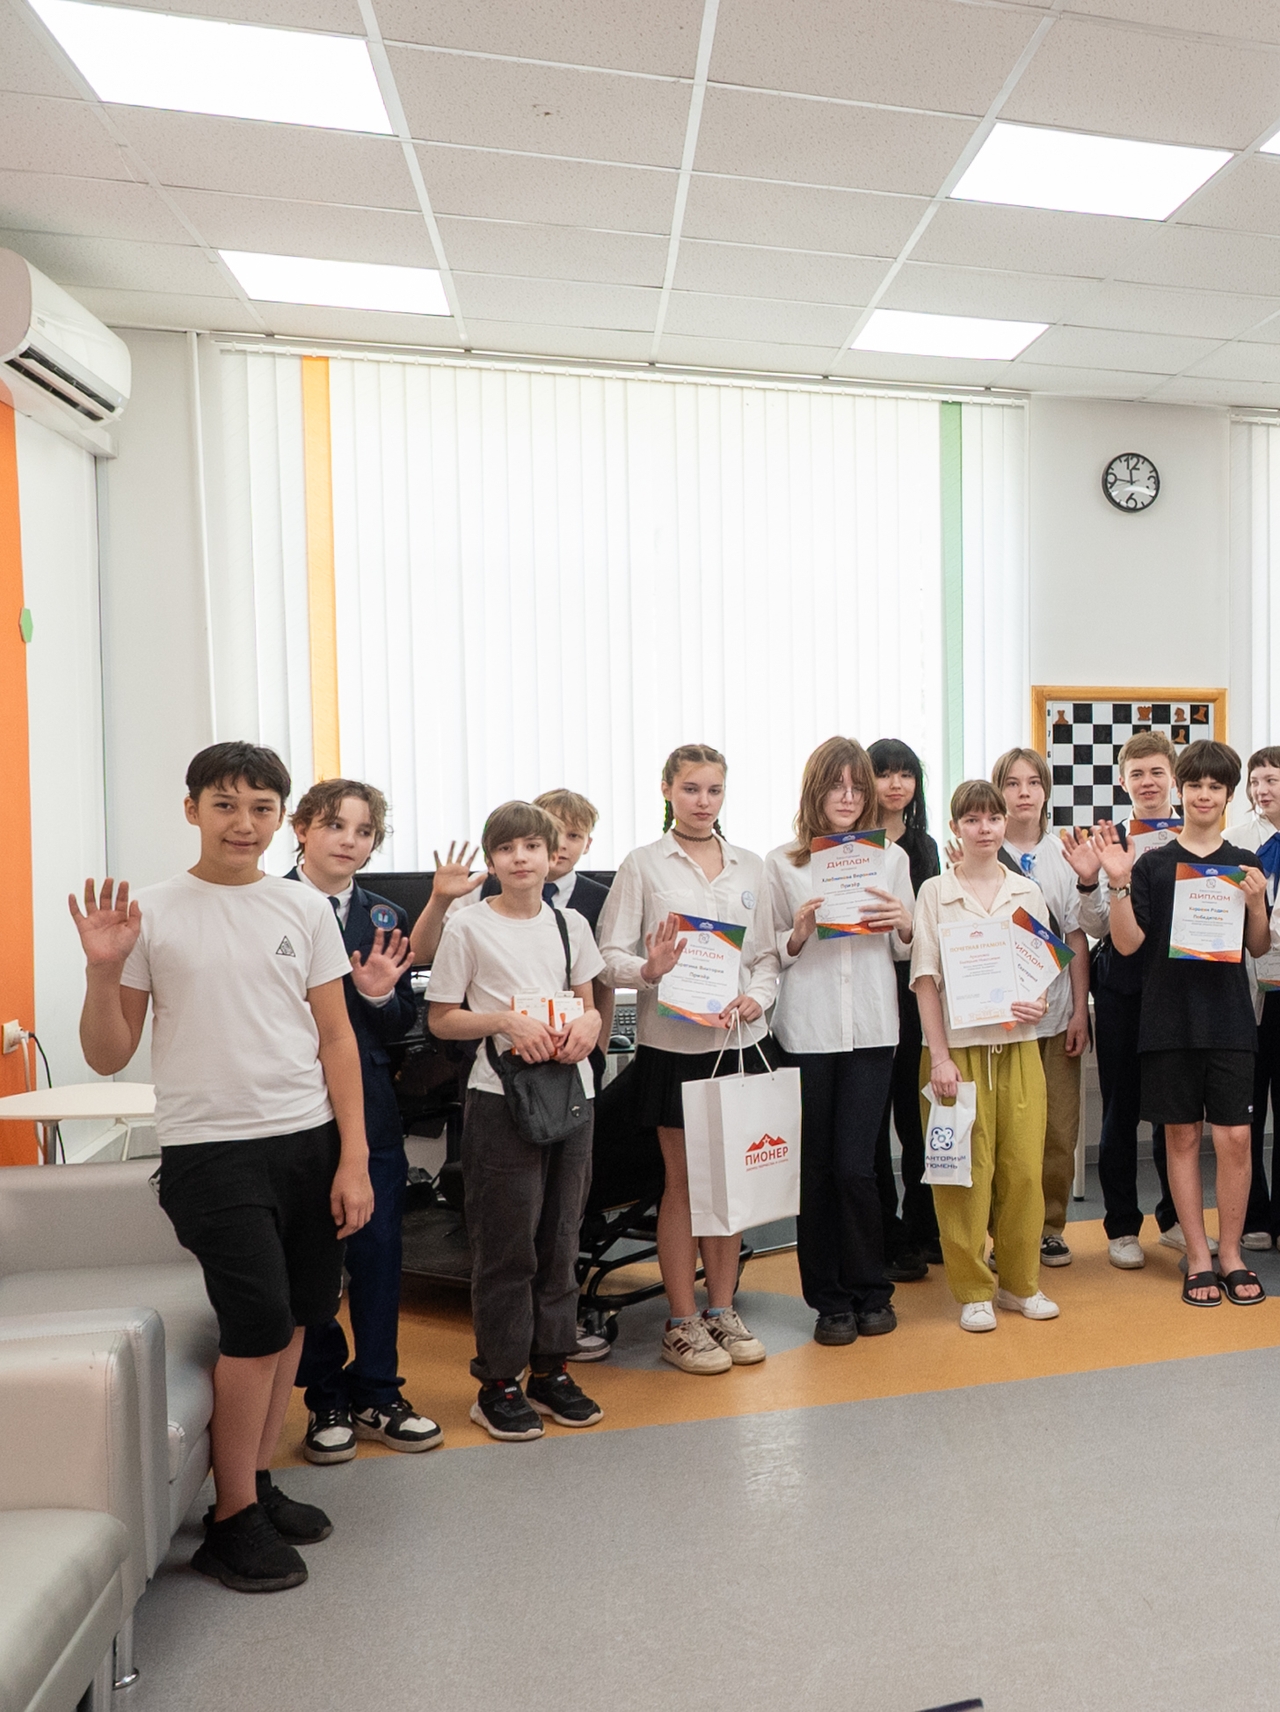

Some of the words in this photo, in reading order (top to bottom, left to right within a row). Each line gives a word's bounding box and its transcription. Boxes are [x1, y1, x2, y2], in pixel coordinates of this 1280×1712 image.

[1124, 456, 1140, 470] 12
[1107, 472, 1117, 489] 9
[1146, 475, 1156, 490] 3
[1126, 493, 1137, 509] 6
[826, 857, 870, 869] ДИПЛОМ
[1189, 892, 1231, 901] ДИПЛОМ
[980, 941, 1007, 949] ГРАМОТА
[682, 947, 724, 960] ДИПЛОМ
[689, 972, 710, 980] Призёр
[745, 1146, 788, 1166] ПИОНЕР
